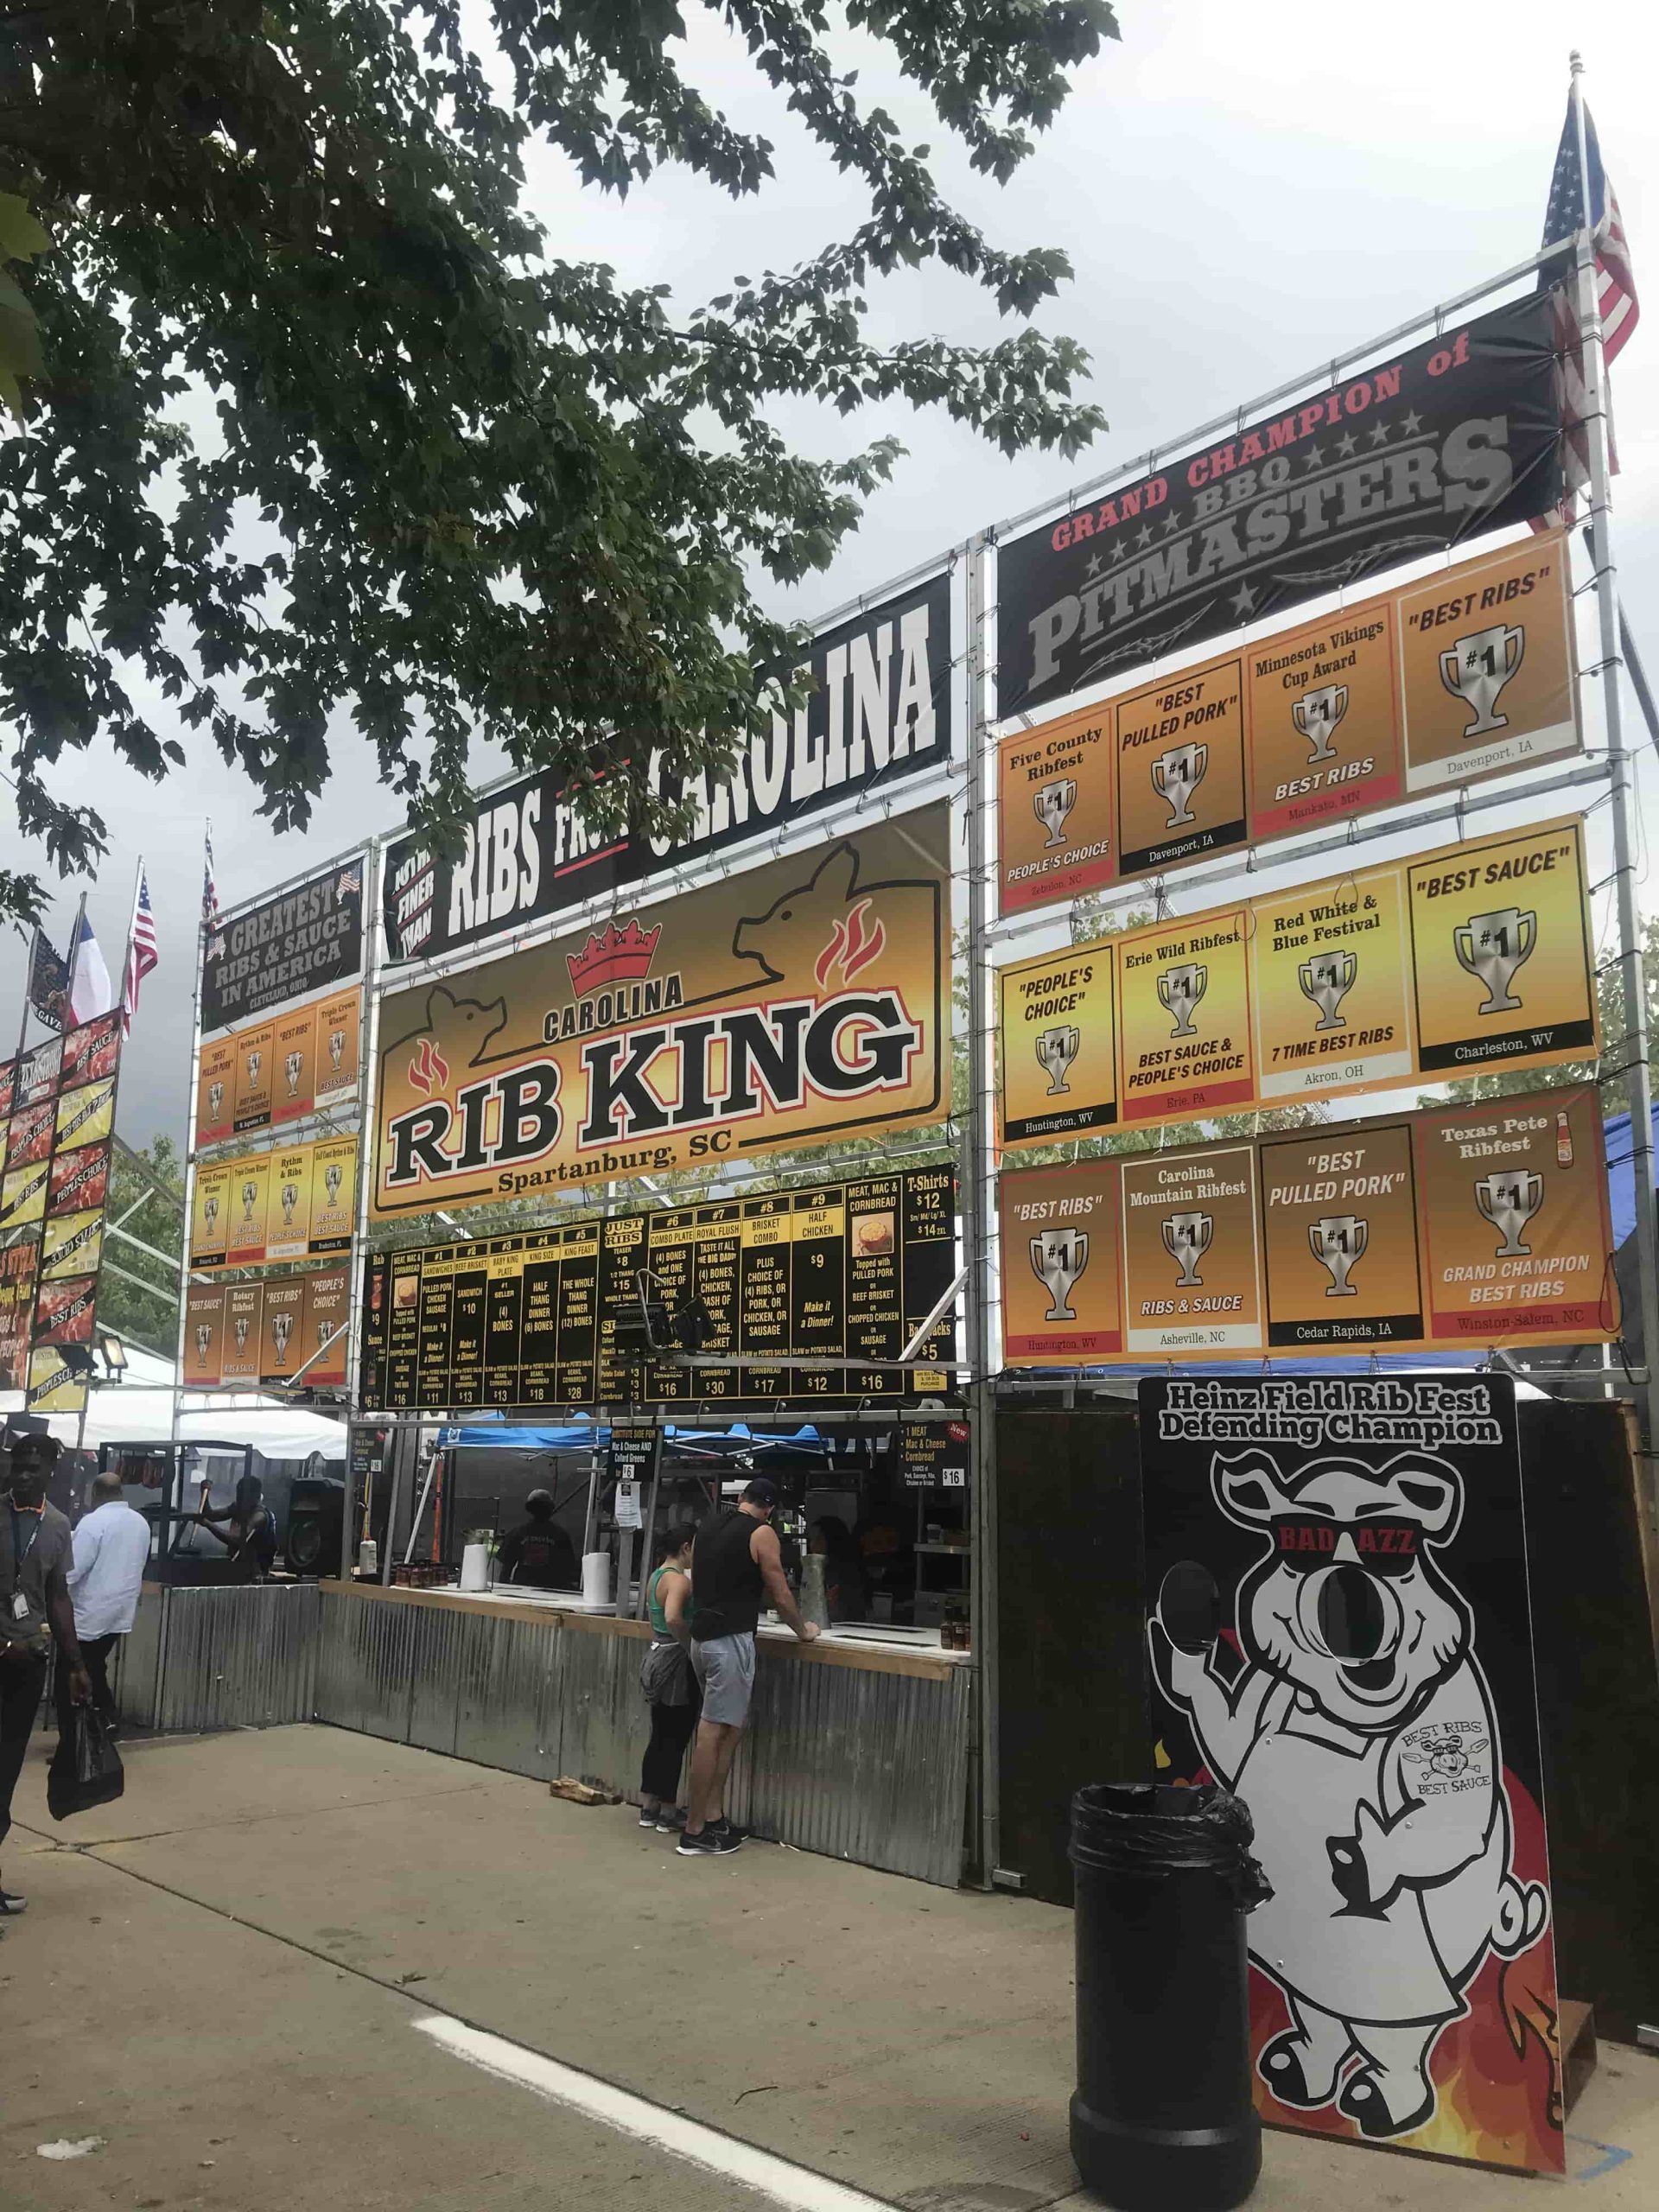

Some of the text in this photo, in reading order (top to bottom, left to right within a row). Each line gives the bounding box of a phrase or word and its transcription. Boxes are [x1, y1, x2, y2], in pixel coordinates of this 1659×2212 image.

[1052, 331, 1469, 553] GRAND CHAMPION of
[1193, 455, 1290, 520] BBQ
[1027, 416, 1513, 690] PITMASTERS
[1409, 567, 1549, 632] "BEST RIBS"
[1255, 621, 1384, 677] Minnesota Vikings
[1282, 652, 1357, 690] Cup Award
[1155, 683, 1205, 713] "BEST
[1122, 696, 1237, 751] PULLED PORK"
[1010, 728, 1102, 770] Five County
[1447, 741, 1532, 774] Davenport, IA
[1027, 753, 1084, 782] Ribfest
[1274, 758, 1375, 801] BEST RIBS
[448, 788, 542, 937] RIBS
[555, 775, 629, 865] FR
[1007, 840, 1109, 882] PEOPLE'S CHOICE
[1149, 835, 1214, 863] Davenport, IA
[1416, 846, 1570, 899] "BEST SAUCE"
[397, 870, 434, 925] FINER
[232, 878, 334, 956] GREATEST
[1274, 895, 1377, 931] Red White &
[401, 907, 432, 960] THAN
[1273, 914, 1381, 951] Blue Festival
[216, 908, 351, 988] RIBS & SAUCE
[1126, 931, 1240, 969] Erie Wild Ribfest
[221, 940, 341, 1007] IN AMERICA
[1020, 966, 1093, 998] "PEOPLE'S
[543, 972, 683, 1045] CAROLINA
[1025, 992, 1084, 1021] CHOICE"
[1140, 1038, 1231, 1068] BEST SAUCE &
[1272, 1027, 1394, 1062] 7 TIME BEST RIBS
[1455, 1033, 1554, 1060] Charleston, WV
[1128, 1054, 1244, 1088] PEOPLE'S CHOICE
[1305, 1065, 1363, 1085] Akron, OH
[385, 985, 924, 1189] RIB KING
[1192, 1092, 1205, 1103] PA
[1026, 1112, 1093, 1134] Huntington, WV
[1441, 1116, 1548, 1142] Texas Pete
[499, 1129, 731, 1193] Spartanburg, SC
[1307, 1149, 1364, 1173] "BEST
[1459, 1137, 1531, 1159] Ribfest
[282, 1157, 302, 1167] Rythm
[286, 1168, 302, 1177] Ribs
[907, 1173, 949, 1192] T-Shirts
[1158, 1166, 1215, 1185] Carolina
[849, 1182, 897, 1198] MEAT, MAC &
[1130, 1180, 1247, 1206] Mountain Ribfest
[1269, 1173, 1405, 1206] PULLED PORK"
[850, 1197, 896, 1211] CORNBREAD
[1014, 1195, 1103, 1221] "BEST RIBS"
[606, 1218, 642, 1233] JUST
[696, 1224, 739, 1238] ROYAL FLUSH
[753, 1218, 780, 1231] BRISKET
[802, 1224, 833, 1237] CHICKEN
[809, 1212, 827, 1224] HALF
[565, 1244, 594, 1255] KING FEAST
[606, 1233, 640, 1246] RIBS
[651, 1231, 693, 1245] COMBO PLATE
[754, 1231, 778, 1244] COMBO
[757, 1257, 774, 1268] PLUS
[1443, 1255, 1590, 1283] GRAND CHAMPION
[747, 1270, 783, 1283] CHOICE OF
[233, 1292, 255, 1301] Rotary
[1141, 1295, 1243, 1316] RIBS & SAUCE
[1470, 1281, 1564, 1304] BEST RIBS
[232, 1302, 255, 1312] Ribfest
[804, 1301, 823, 1313] Make
[1563, 1310, 1584, 1323] NC
[749, 1325, 781, 1337] SAUSAGE
[807, 1315, 833, 1327] Dinner!
[1296, 1323, 1391, 1339] Cedar Rapids, IA
[861, 1335, 887, 1345] SAUSAGE
[1160, 1330, 1224, 1344] Asheville, NC
[1166, 1382, 1491, 1414] Heinz Field Rib Fest
[912, 1427, 927, 1436] MEAT
[950, 1423, 967, 1436] New
[1160, 1410, 1503, 1451] Defending Champion
[906, 1440, 918, 1448] Mac
[926, 1440, 946, 1448] Cheese
[906, 1452, 935, 1462] Cornbread
[1279, 1527, 1417, 1553] BAD AZZ
[1402, 1721, 1482, 1747] BEST RIBS
[1417, 1776, 1491, 1794] BEST SAUCE
